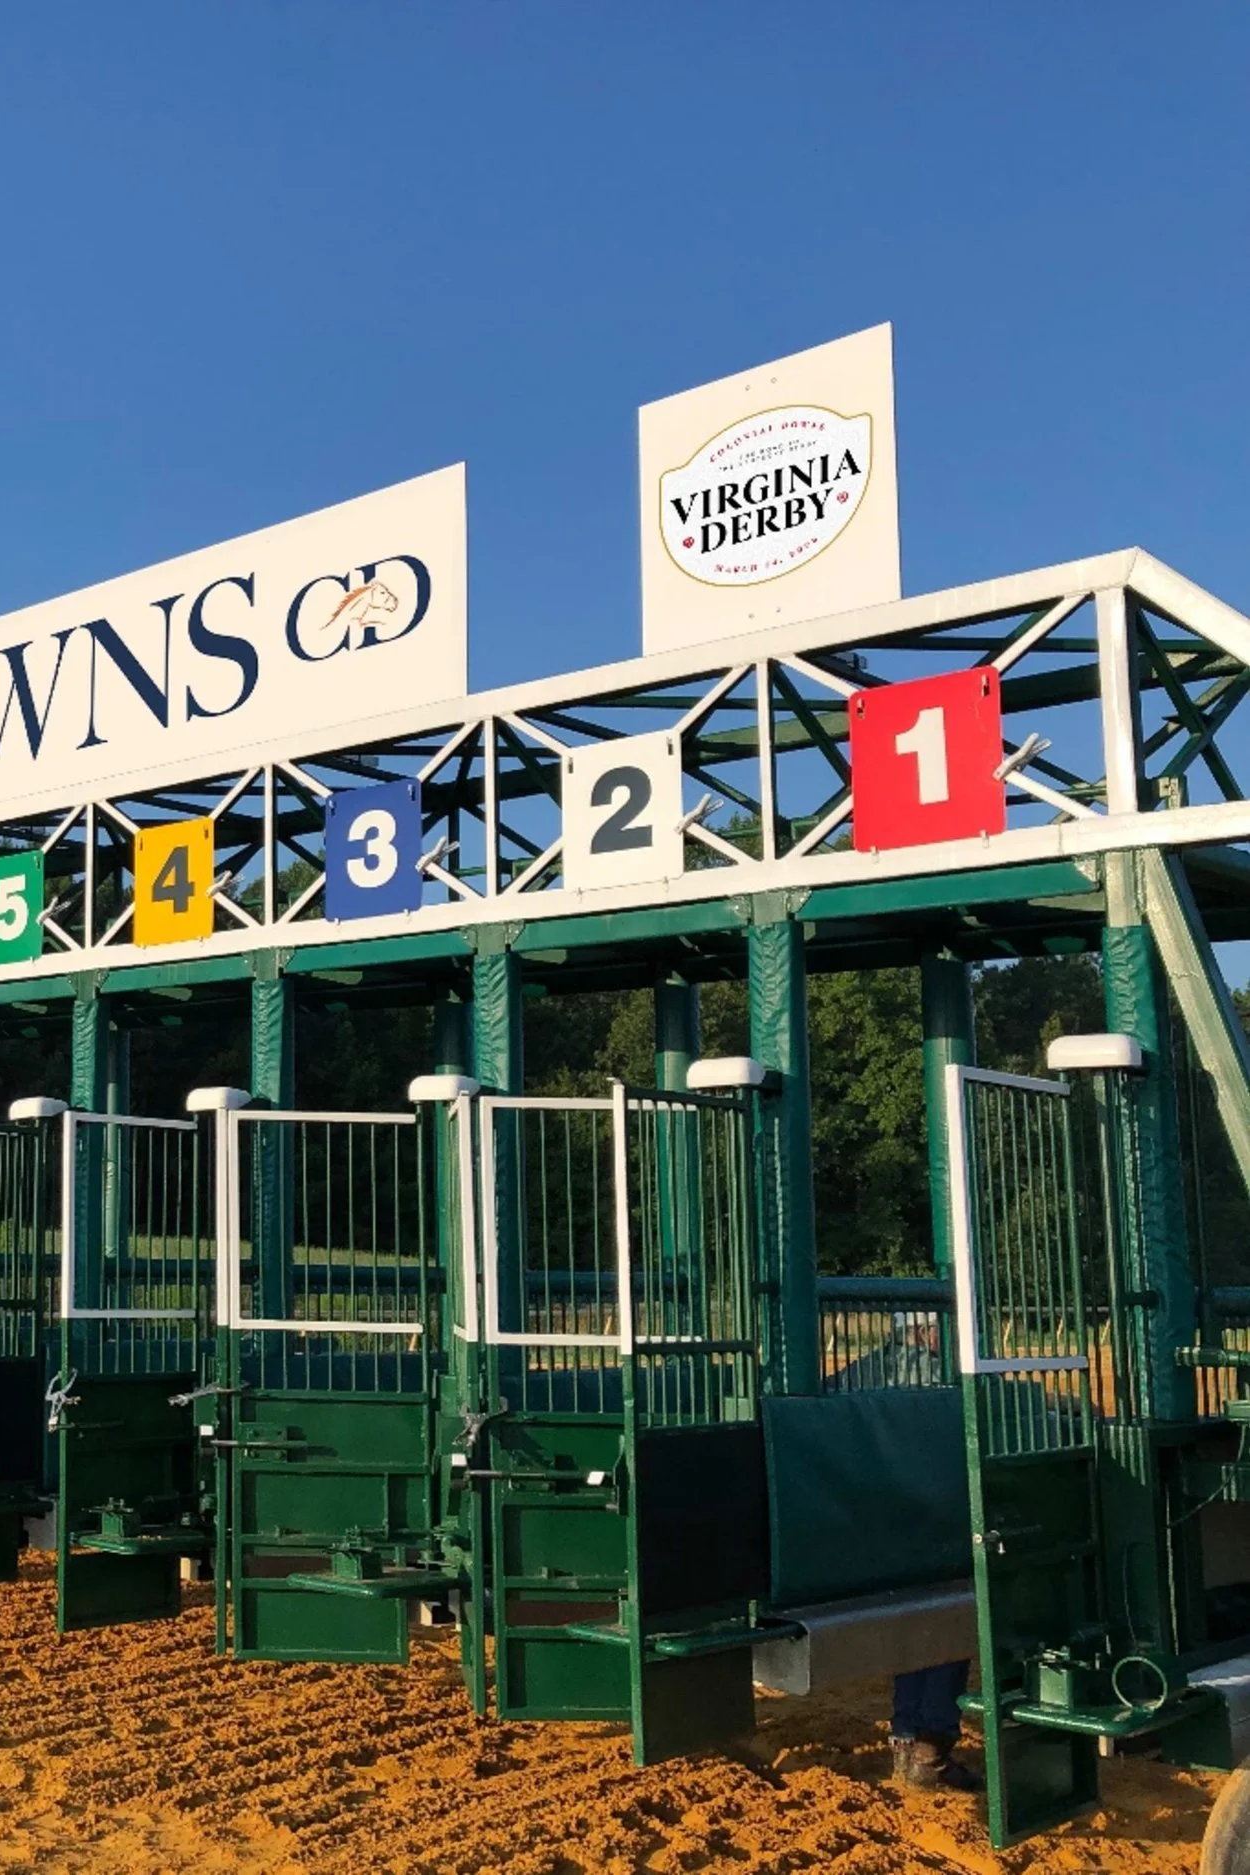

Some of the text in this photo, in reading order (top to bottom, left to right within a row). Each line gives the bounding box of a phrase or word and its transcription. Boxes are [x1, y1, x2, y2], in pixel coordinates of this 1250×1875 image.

[670, 448, 861, 525] VIRGINIA
[700, 487, 834, 554] DERBY
[895, 706, 949, 805] 1
[346, 810, 398, 887] 3
[589, 766, 653, 854] 2
[151, 846, 195, 913] 4
